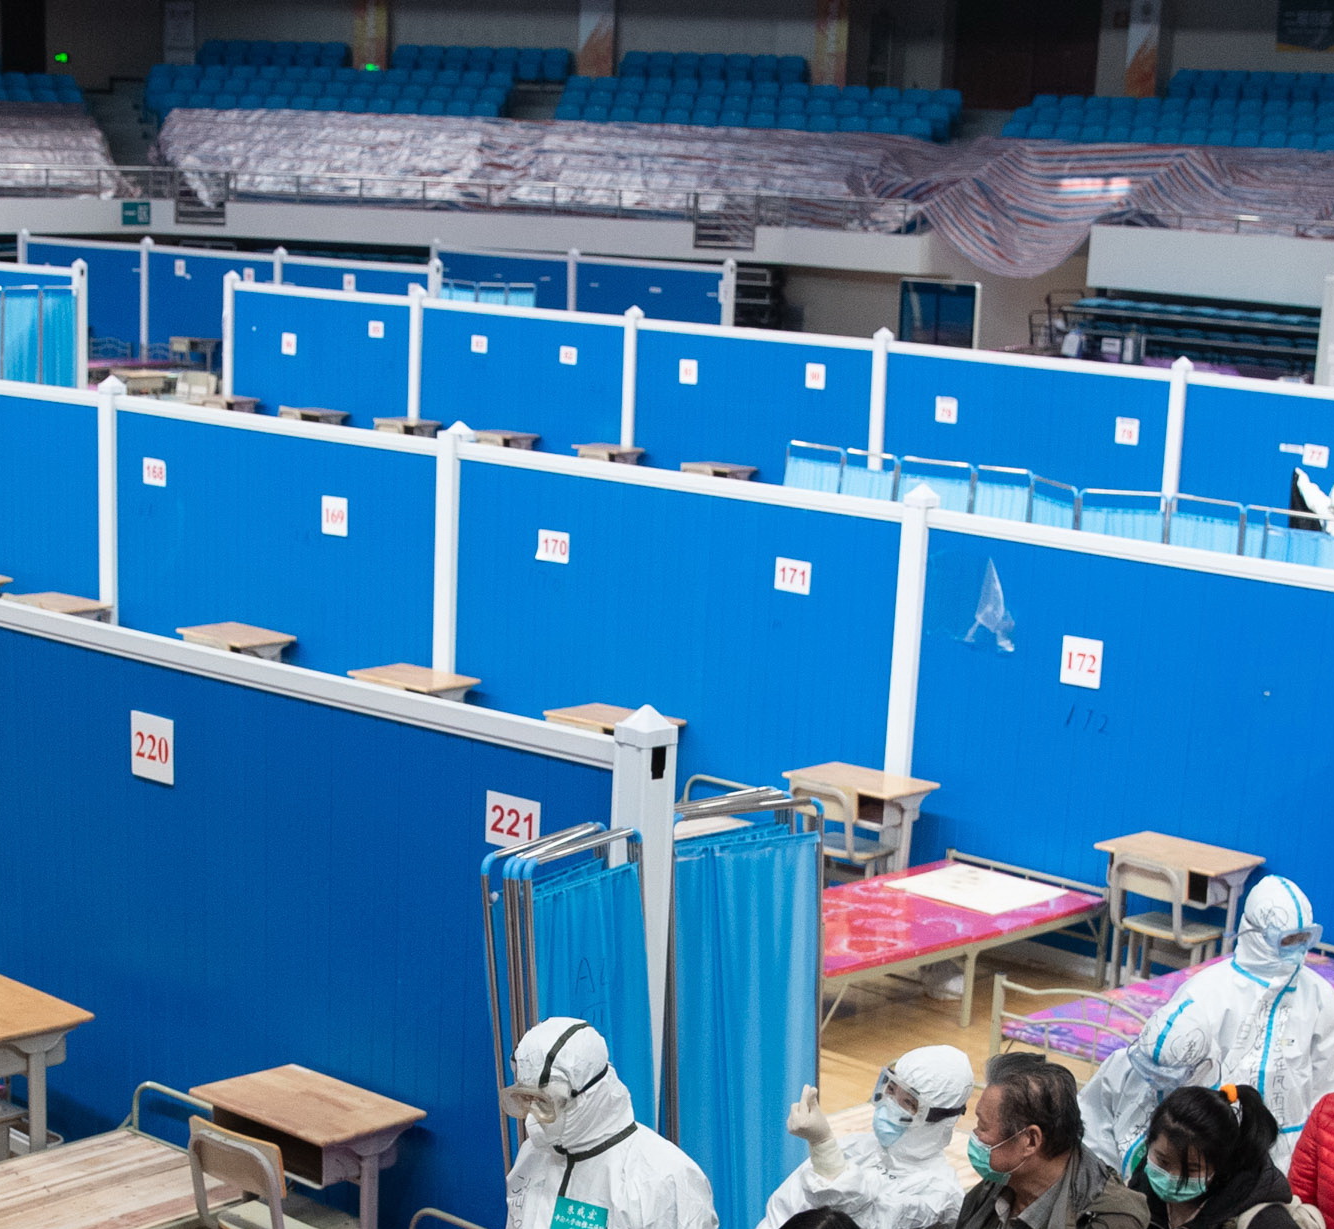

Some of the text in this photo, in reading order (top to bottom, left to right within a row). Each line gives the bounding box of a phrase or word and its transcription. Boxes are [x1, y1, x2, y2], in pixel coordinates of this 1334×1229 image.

[1310, 449, 1323, 462] 77
[145, 463, 165, 482] 168
[323, 508, 346, 526] 169
[542, 537, 569, 556] 170
[779, 567, 808, 586] 171
[1066, 651, 1097, 675] 172
[135, 731, 169, 764] 220
[490, 805, 533, 841] 221
